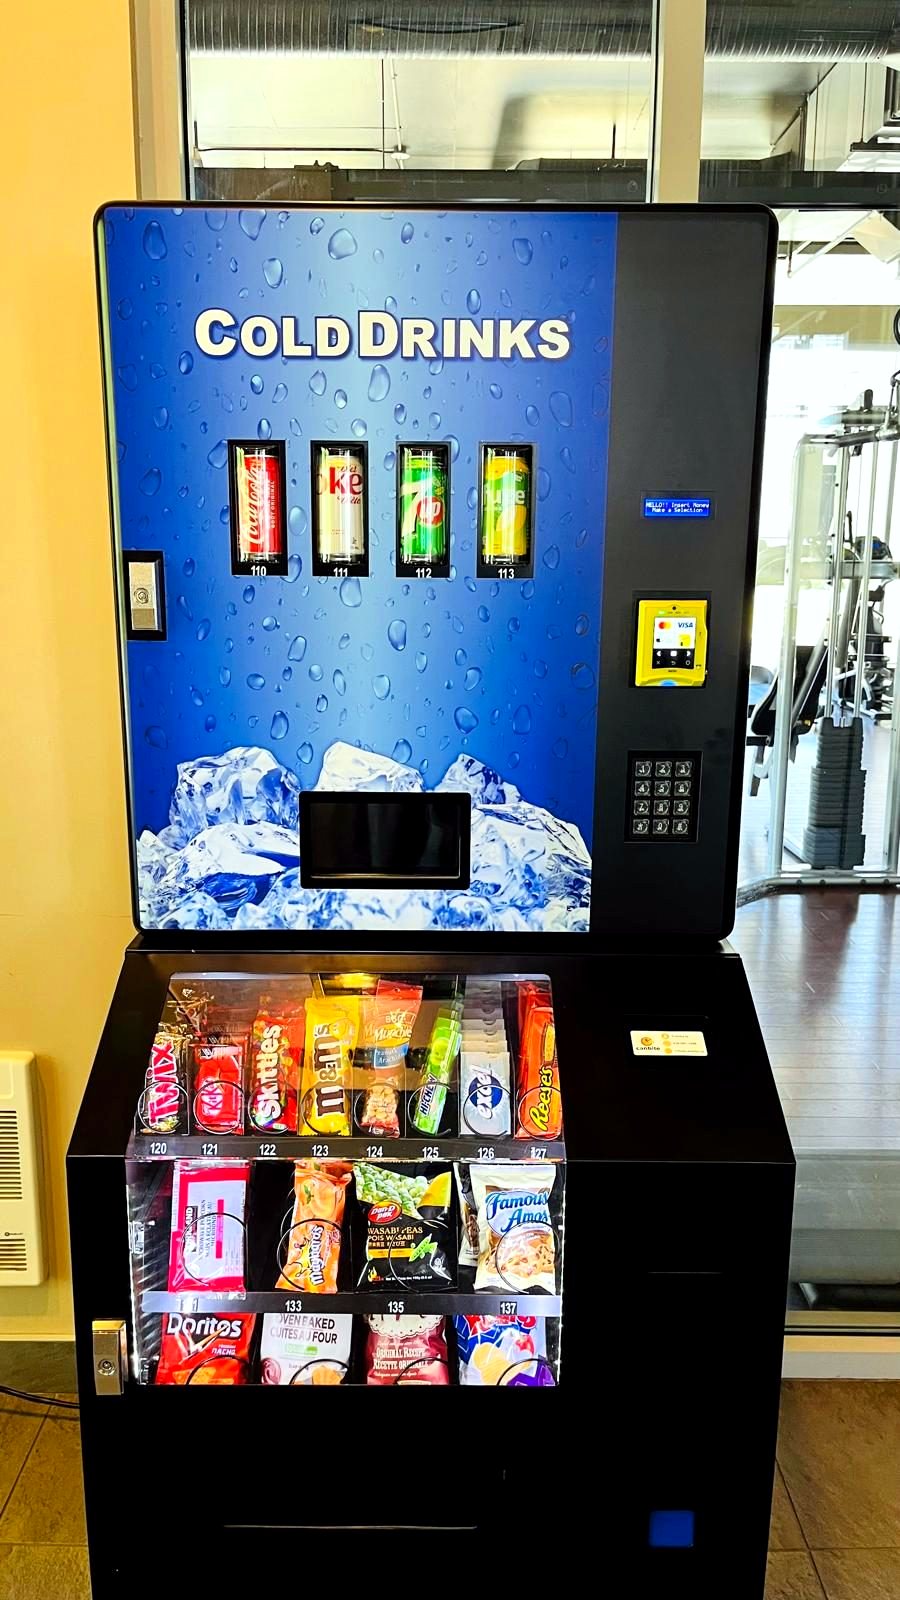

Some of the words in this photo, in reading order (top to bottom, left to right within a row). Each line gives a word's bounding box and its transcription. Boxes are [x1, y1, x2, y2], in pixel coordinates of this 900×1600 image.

[251, 566, 267, 576] 110
[333, 567, 349, 577] 111
[415, 568, 432, 578] 112
[497, 568, 515, 579] 113
[256, 1025, 282, 1119] Skittles
[150, 1142, 166, 1154] 120
[202, 1144, 218, 1155] 121
[259, 1144, 276, 1156] 122
[312, 1144, 328, 1156] 123
[366, 1146, 383, 1158] 124
[422, 1147, 438, 1158] 125
[478, 1148, 494, 1158] 126
[530, 1148, 546, 1160] 127
[485, 1190, 549, 1221] Famous
[500, 1208, 548, 1233] Amos
[308, 1225, 325, 1287] Maynards
[285, 1300, 302, 1312] 133
[388, 1302, 404, 1313] 135
[500, 1302, 516, 1314] 137
[167, 1312, 242, 1338] Doritos
[312, 1331, 338, 1344] FOUR
[376, 1348, 403, 1358] ORIGINAL
[374, 1359, 398, 1370] RECETTE
